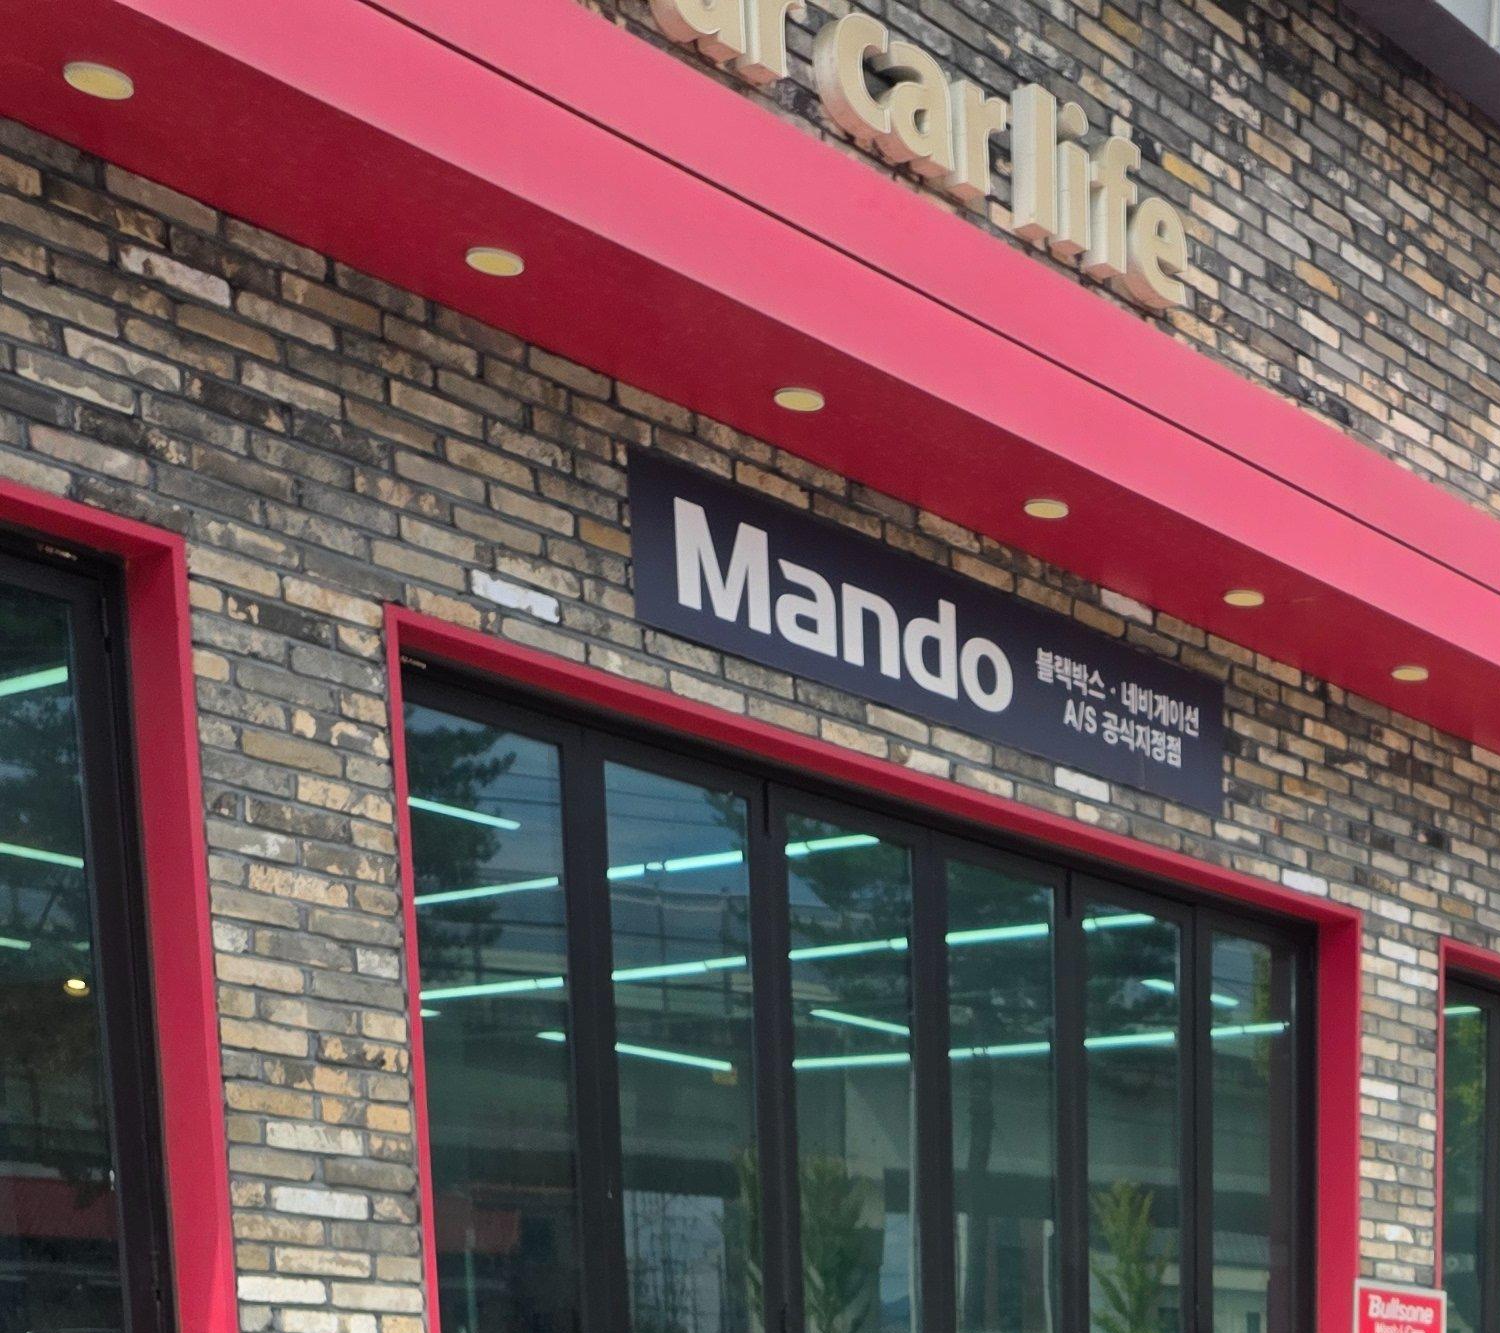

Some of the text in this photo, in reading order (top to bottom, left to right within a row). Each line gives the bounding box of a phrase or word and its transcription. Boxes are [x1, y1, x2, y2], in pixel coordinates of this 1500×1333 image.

[673, 496, 1014, 713] Mando
[1035, 647, 1199, 737] 블랙박스 네비게이션
[1063, 698, 1182, 768] A/S 공식지정점
[1367, 1293, 1434, 1326] Bullsone
